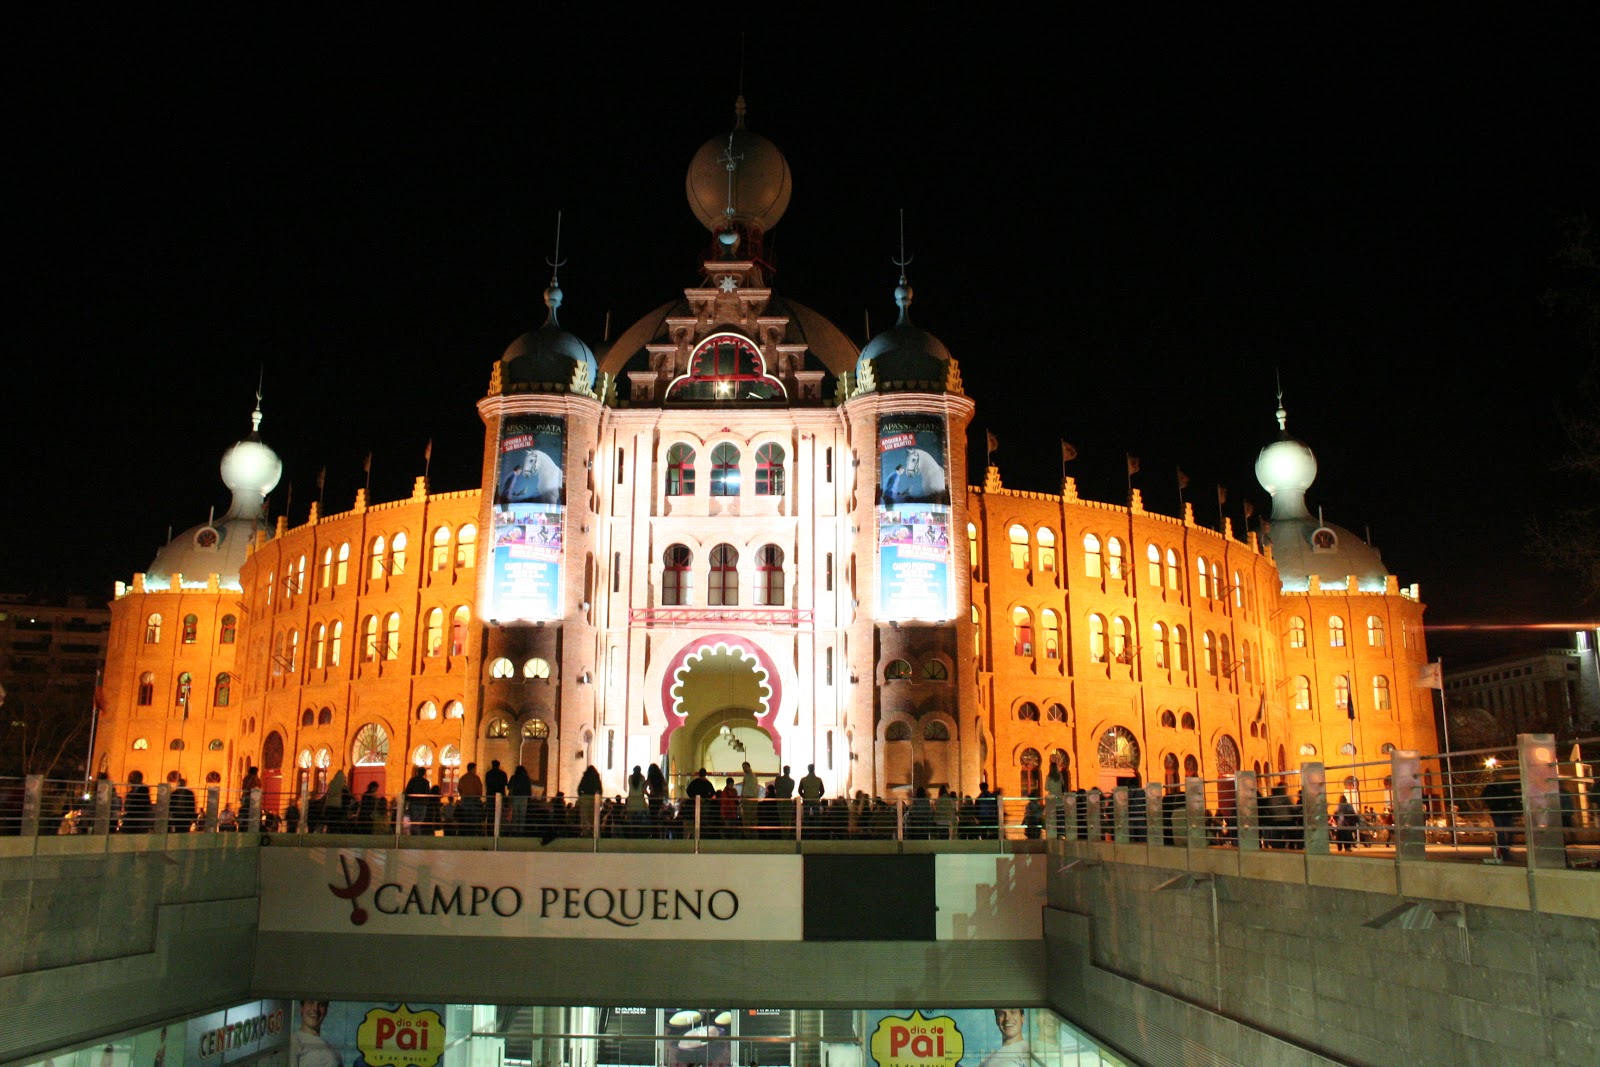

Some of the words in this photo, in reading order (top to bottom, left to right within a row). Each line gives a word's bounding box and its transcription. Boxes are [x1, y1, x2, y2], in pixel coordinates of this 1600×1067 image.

[374, 883, 522, 917] CAMPO
[540, 887, 740, 927] PEQUENO
[375, 1017, 429, 1051] Pai
[396, 1018, 412, 1027] dia
[910, 1025, 927, 1034] dia
[890, 1025, 945, 1058] Pai
